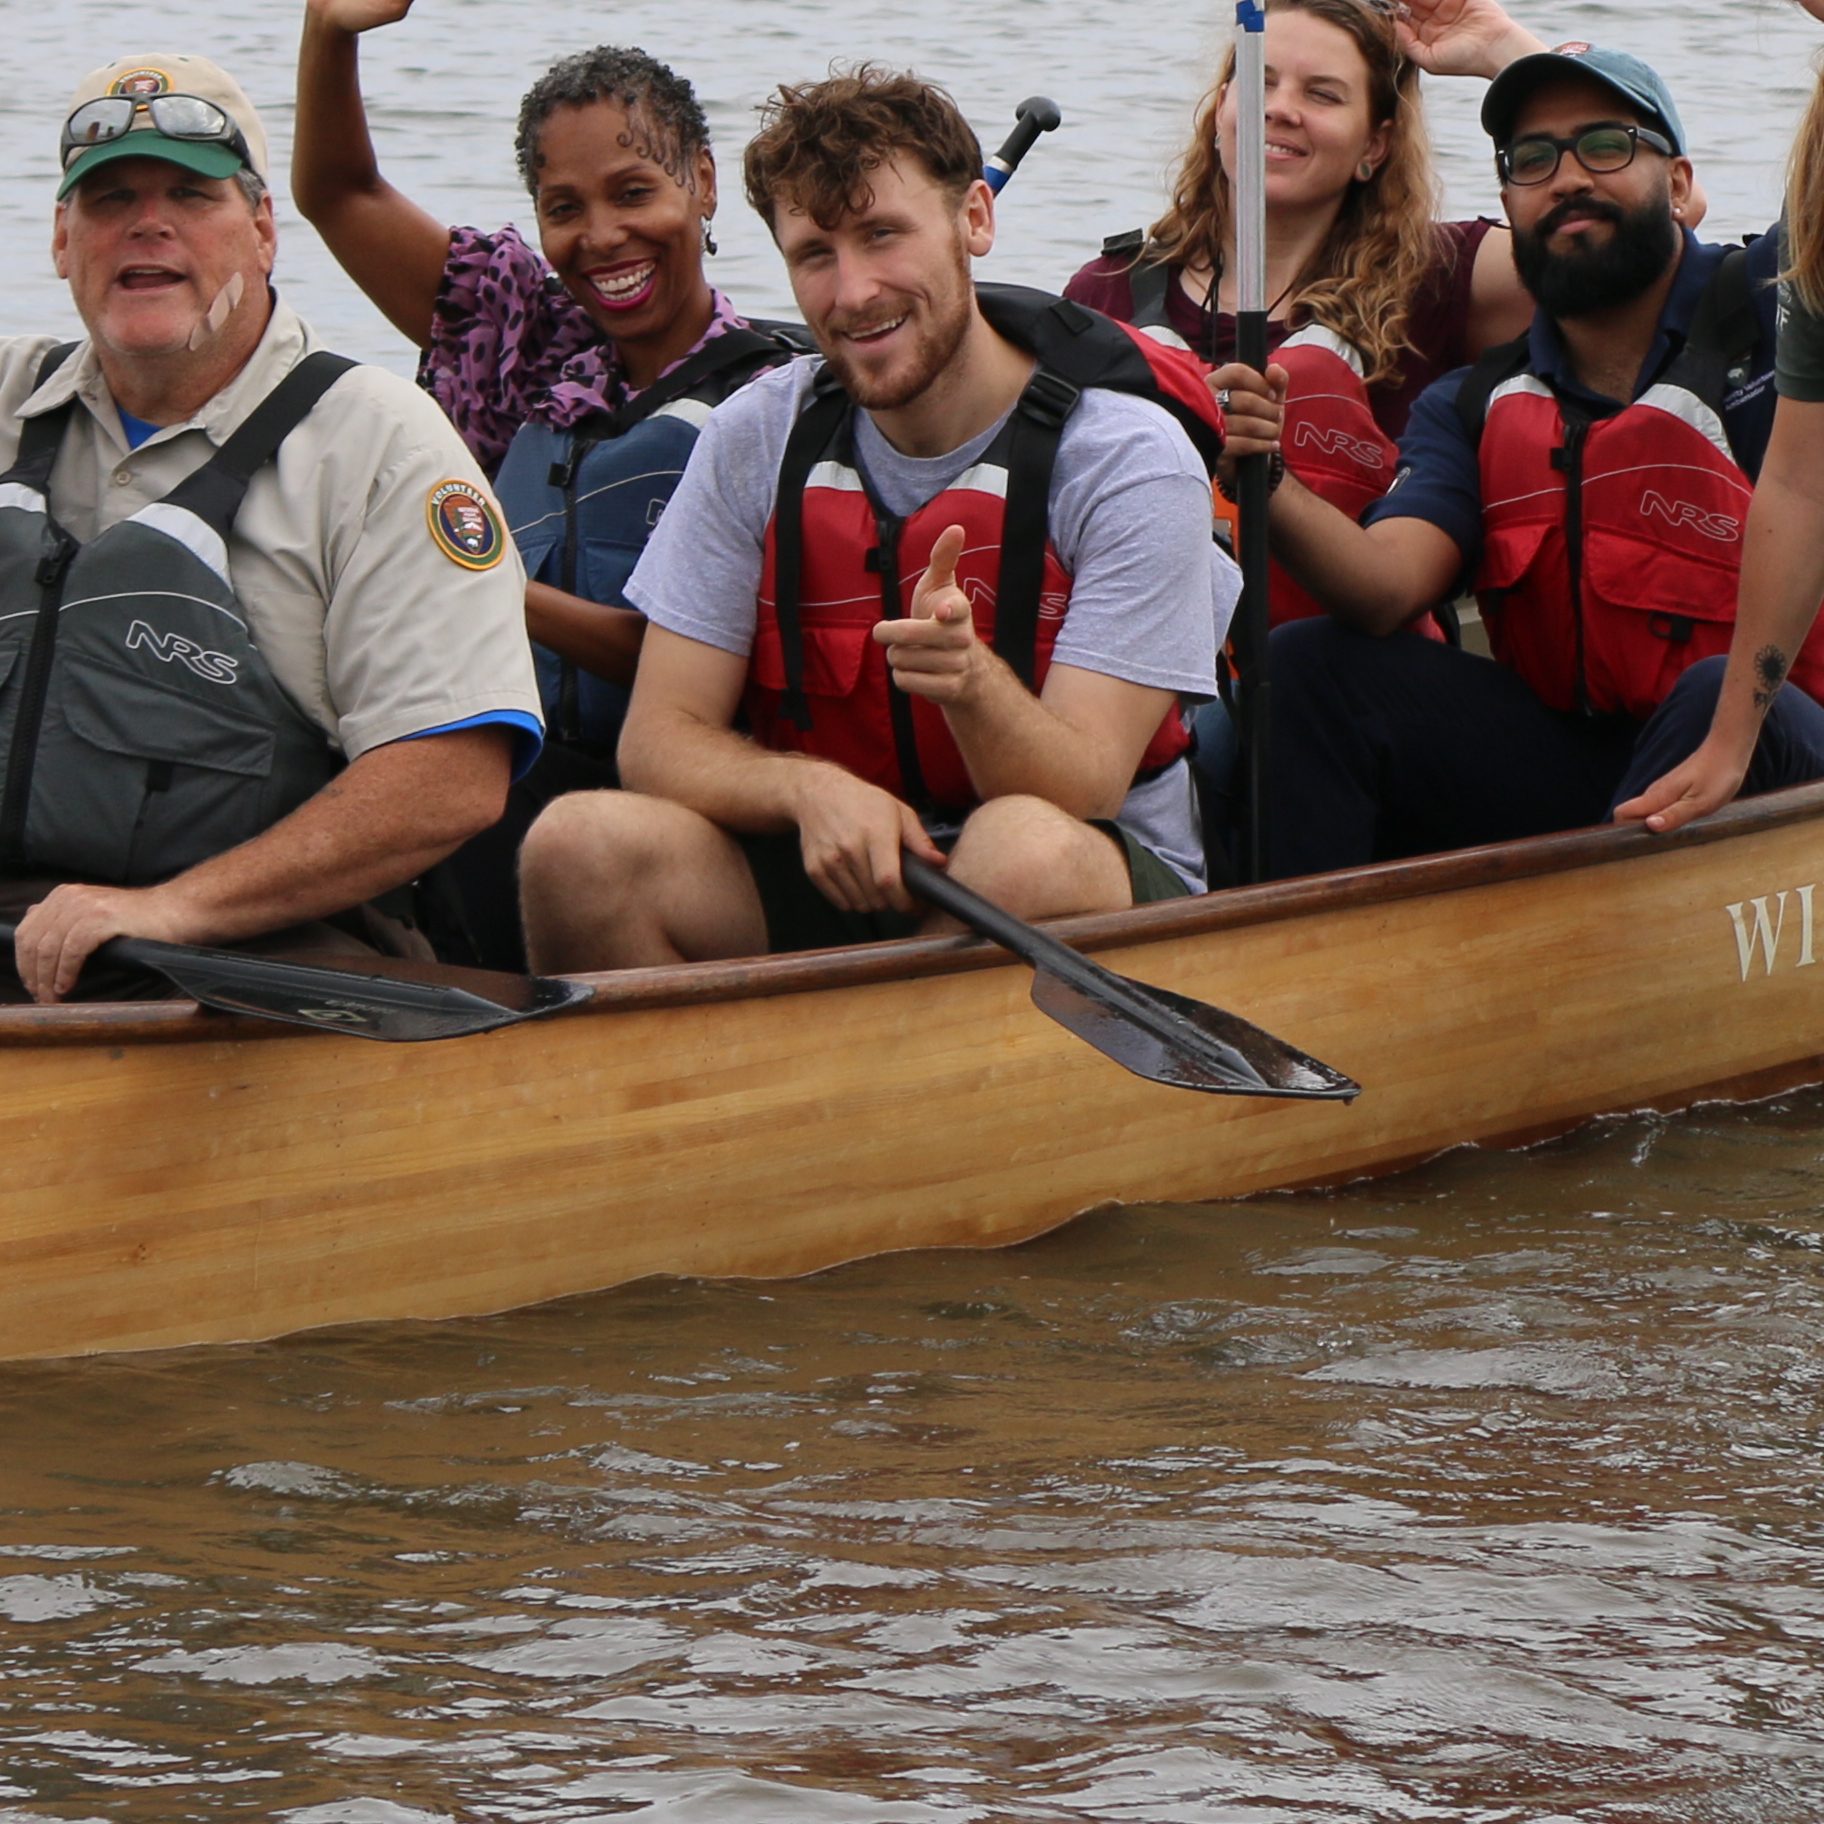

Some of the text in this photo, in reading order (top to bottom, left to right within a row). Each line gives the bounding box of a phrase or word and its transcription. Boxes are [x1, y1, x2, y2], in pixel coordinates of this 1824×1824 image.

[1294, 421, 1383, 469] NRS
[431, 483, 486, 506] VOLUNTEER
[1639, 489, 1739, 542] NRS
[963, 577, 1068, 620] NS
[125, 619, 238, 685] NRS
